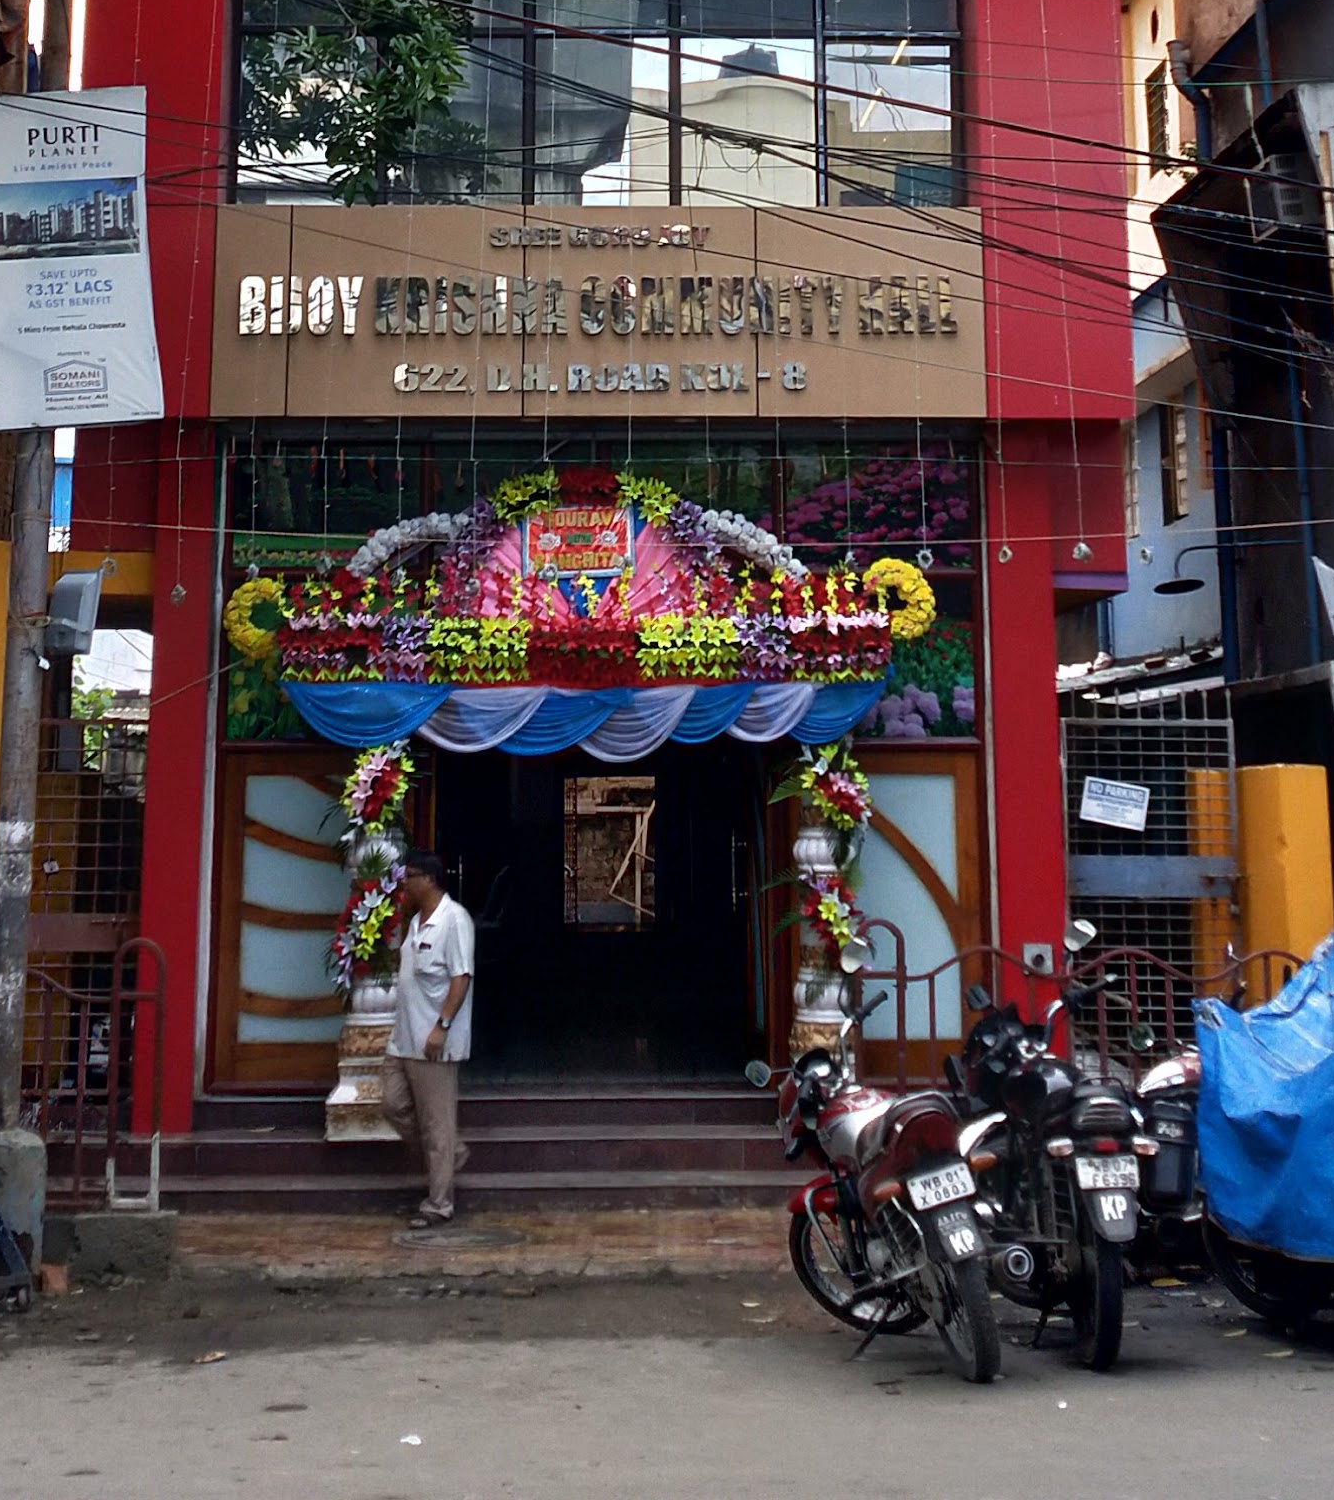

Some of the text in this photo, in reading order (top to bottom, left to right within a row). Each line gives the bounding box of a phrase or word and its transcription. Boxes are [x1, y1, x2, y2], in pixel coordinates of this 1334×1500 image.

[28, 124, 100, 145] PURTI
[29, 146, 99, 158] PLANET
[40, 162, 77, 171] Amidst
[82, 161, 113, 169] Peace
[489, 225, 562, 247] SREE
[39, 268, 97, 280] SAVE UPTO
[74, 279, 113, 294] LACS
[28, 296, 111, 309] AS GST BENEFIT
[239, 274, 958, 336] BIJOY KRISHNA COMMUNITY HALL
[50, 371, 100, 381] SOMANI
[50, 380, 101, 390] REALTORS
[487, 363, 558, 392] D.H.
[567, 363, 670, 392] ROAD
[680, 363, 749, 392] KOL
[782, 363, 806, 391] 8
[1090, 782, 1145, 802] NO PARKING
[920, 1170, 960, 1191] WB 01
[1100, 1195, 1127, 1221] KP
[949, 1229, 975, 1256] KP
